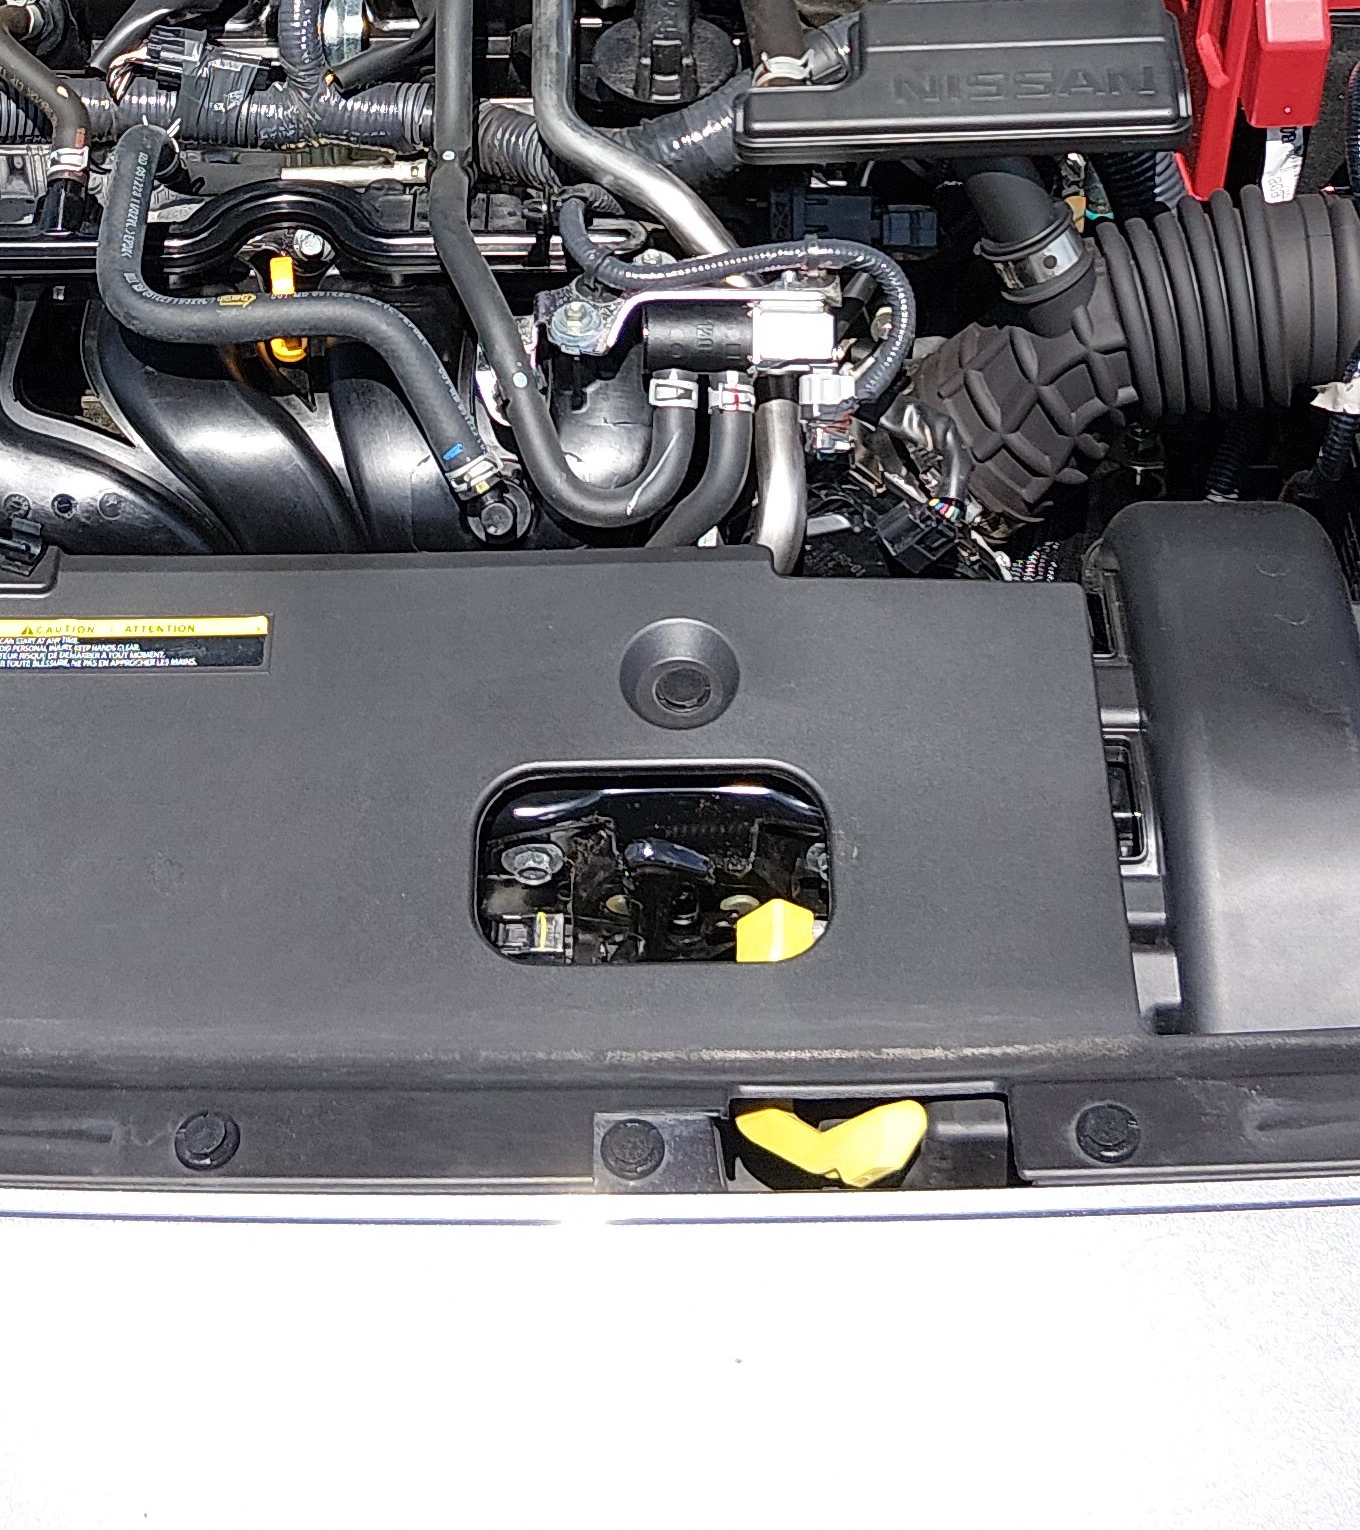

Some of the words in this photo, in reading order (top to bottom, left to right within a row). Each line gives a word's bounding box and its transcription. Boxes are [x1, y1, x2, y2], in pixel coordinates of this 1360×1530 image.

[893, 66, 1156, 104] NISSAN
[36, 625, 95, 634] CAUTION
[125, 624, 196, 633] ATTENTION
[19, 652, 46, 660] RISQUE
[108, 651, 129, 659] TOUT
[7, 660, 31, 668] TOUTE
[82, 659, 98, 667] PAS
[110, 658, 156, 667] APPROCHER
[156, 658, 170, 666] LES
